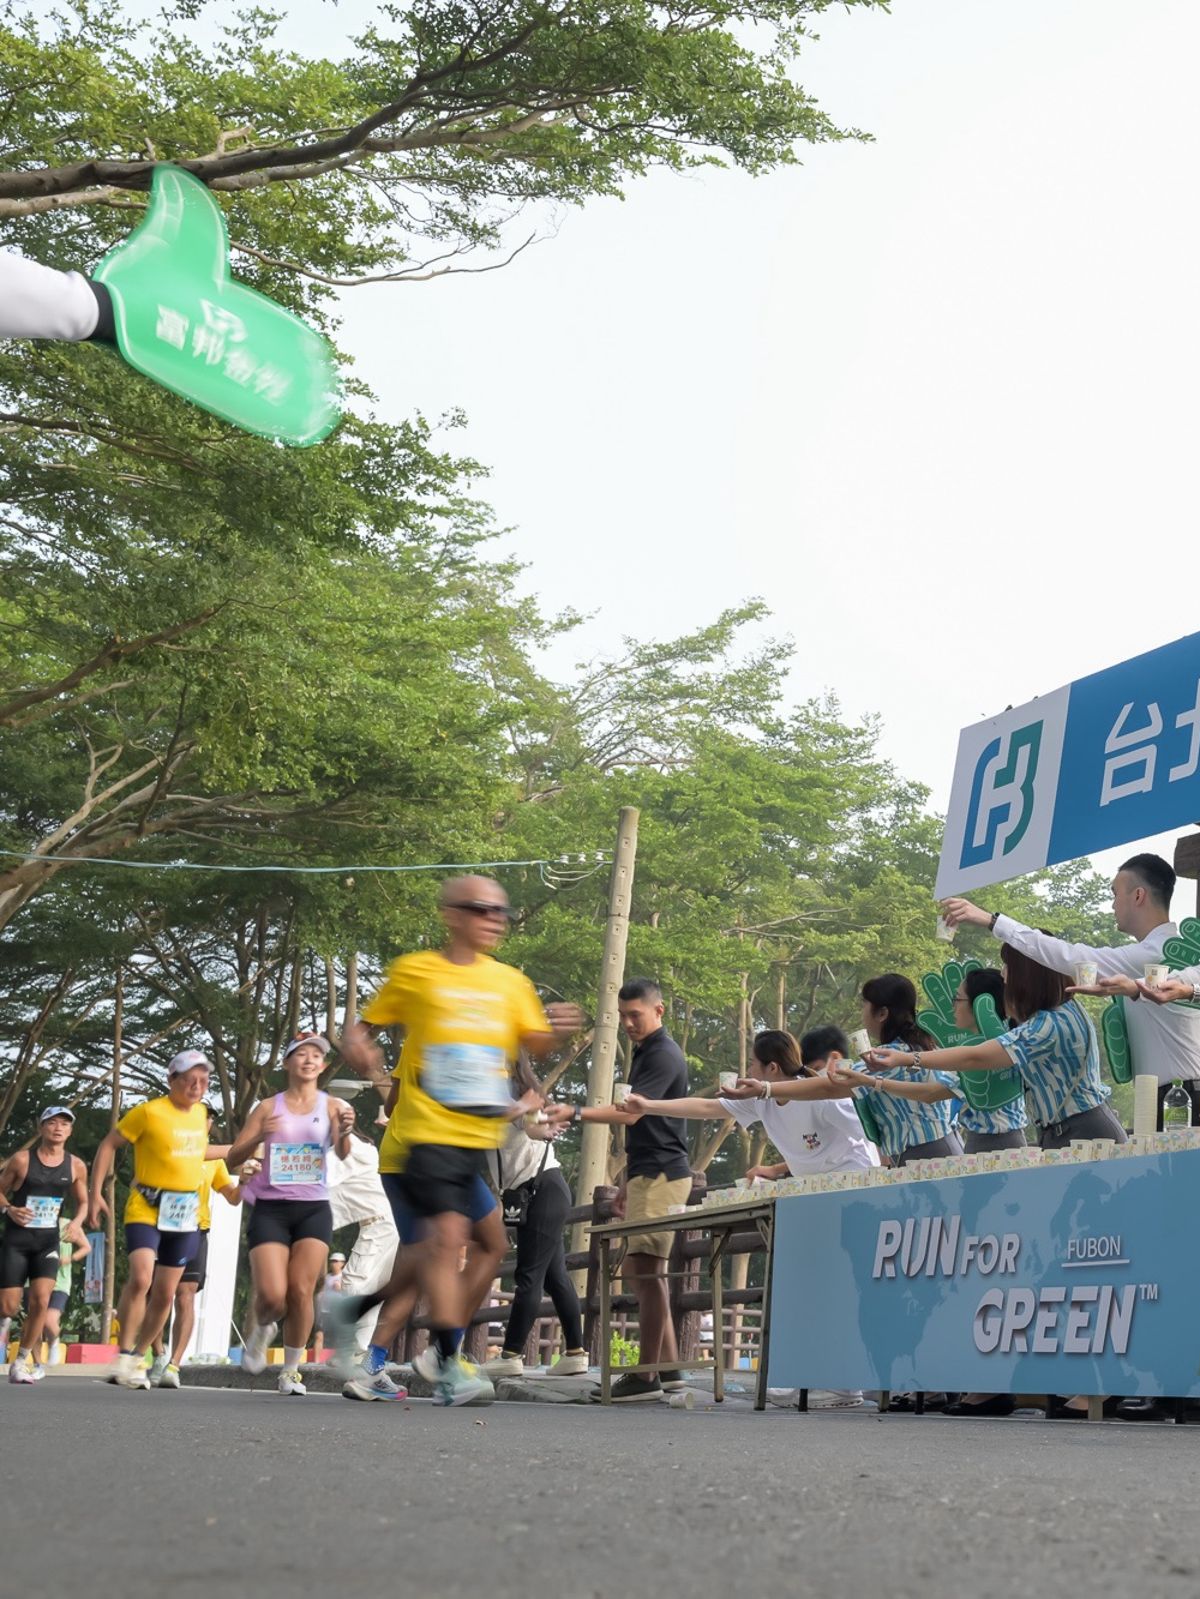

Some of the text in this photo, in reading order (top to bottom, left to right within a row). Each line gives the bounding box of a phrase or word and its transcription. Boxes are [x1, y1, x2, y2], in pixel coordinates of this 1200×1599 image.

[873, 1215, 1020, 1278] RUN FOR
[1067, 1235, 1121, 1260] FUBON
[973, 1284, 1137, 1354] GREEN
